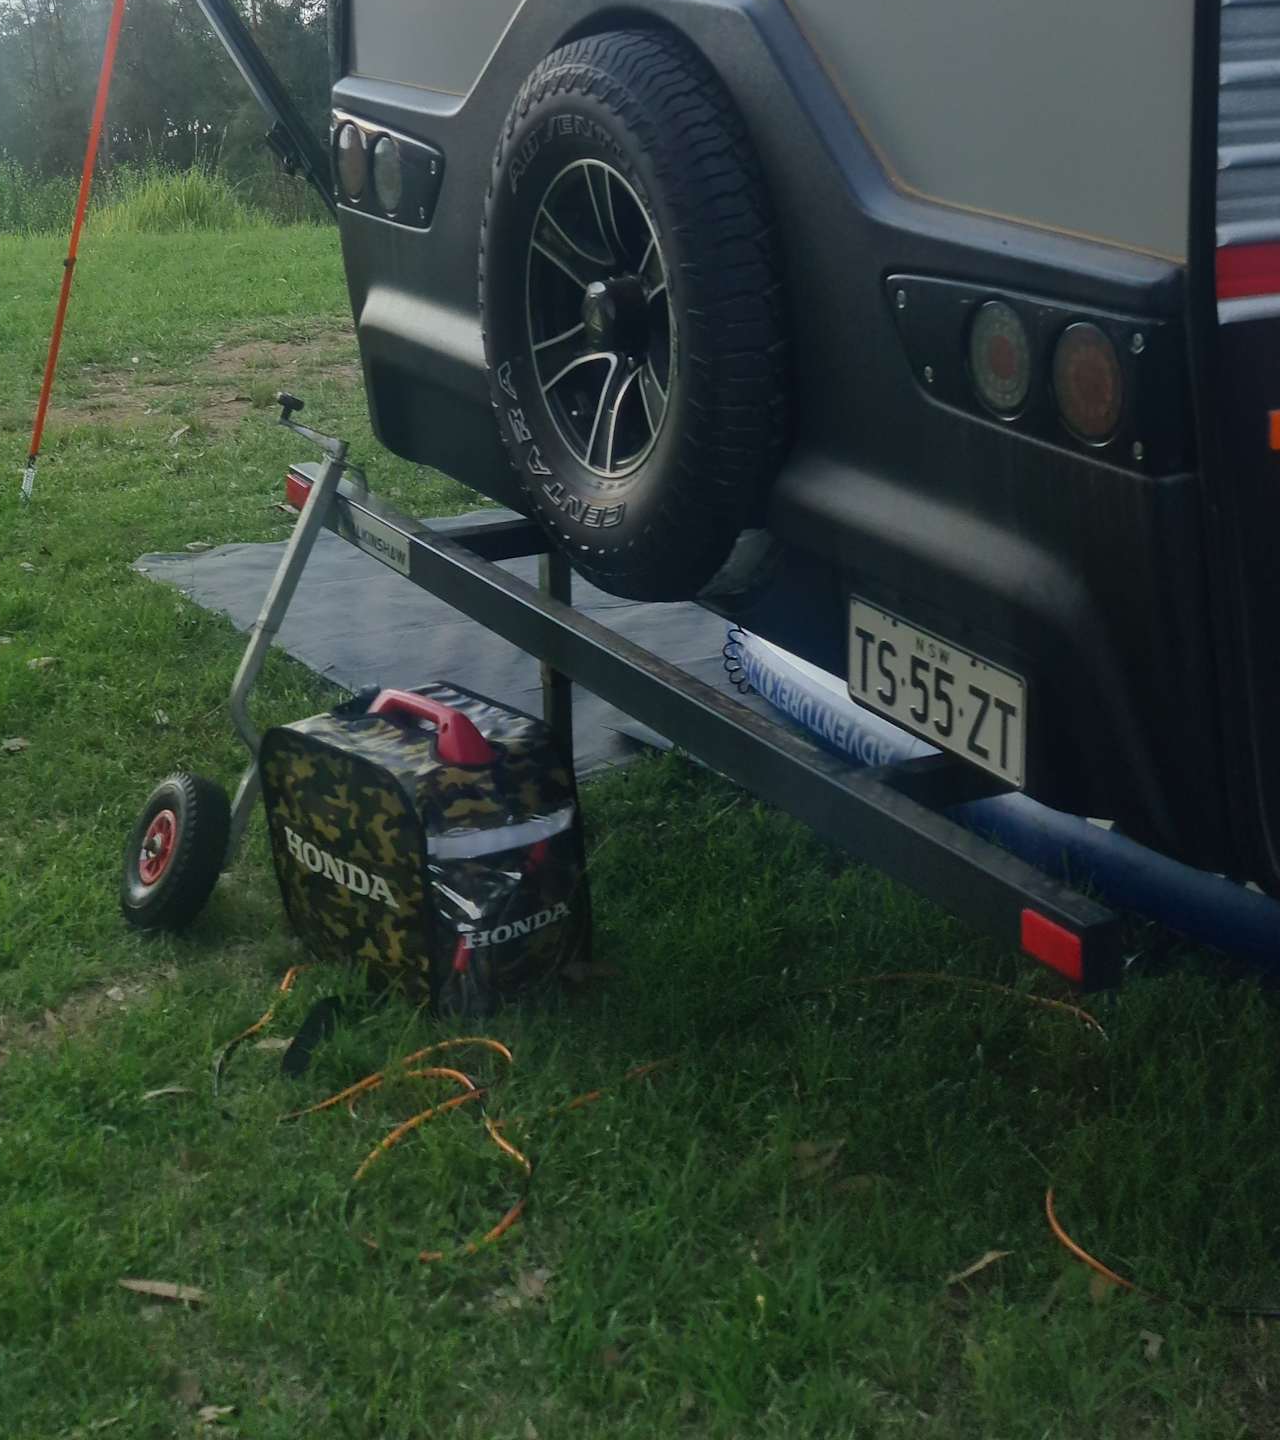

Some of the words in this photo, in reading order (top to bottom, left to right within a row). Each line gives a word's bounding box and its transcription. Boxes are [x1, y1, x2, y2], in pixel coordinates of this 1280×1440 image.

[915, 636, 951, 665] NSW
[283, 825, 401, 910] HONDA
[463, 901, 572, 951] HONDA
